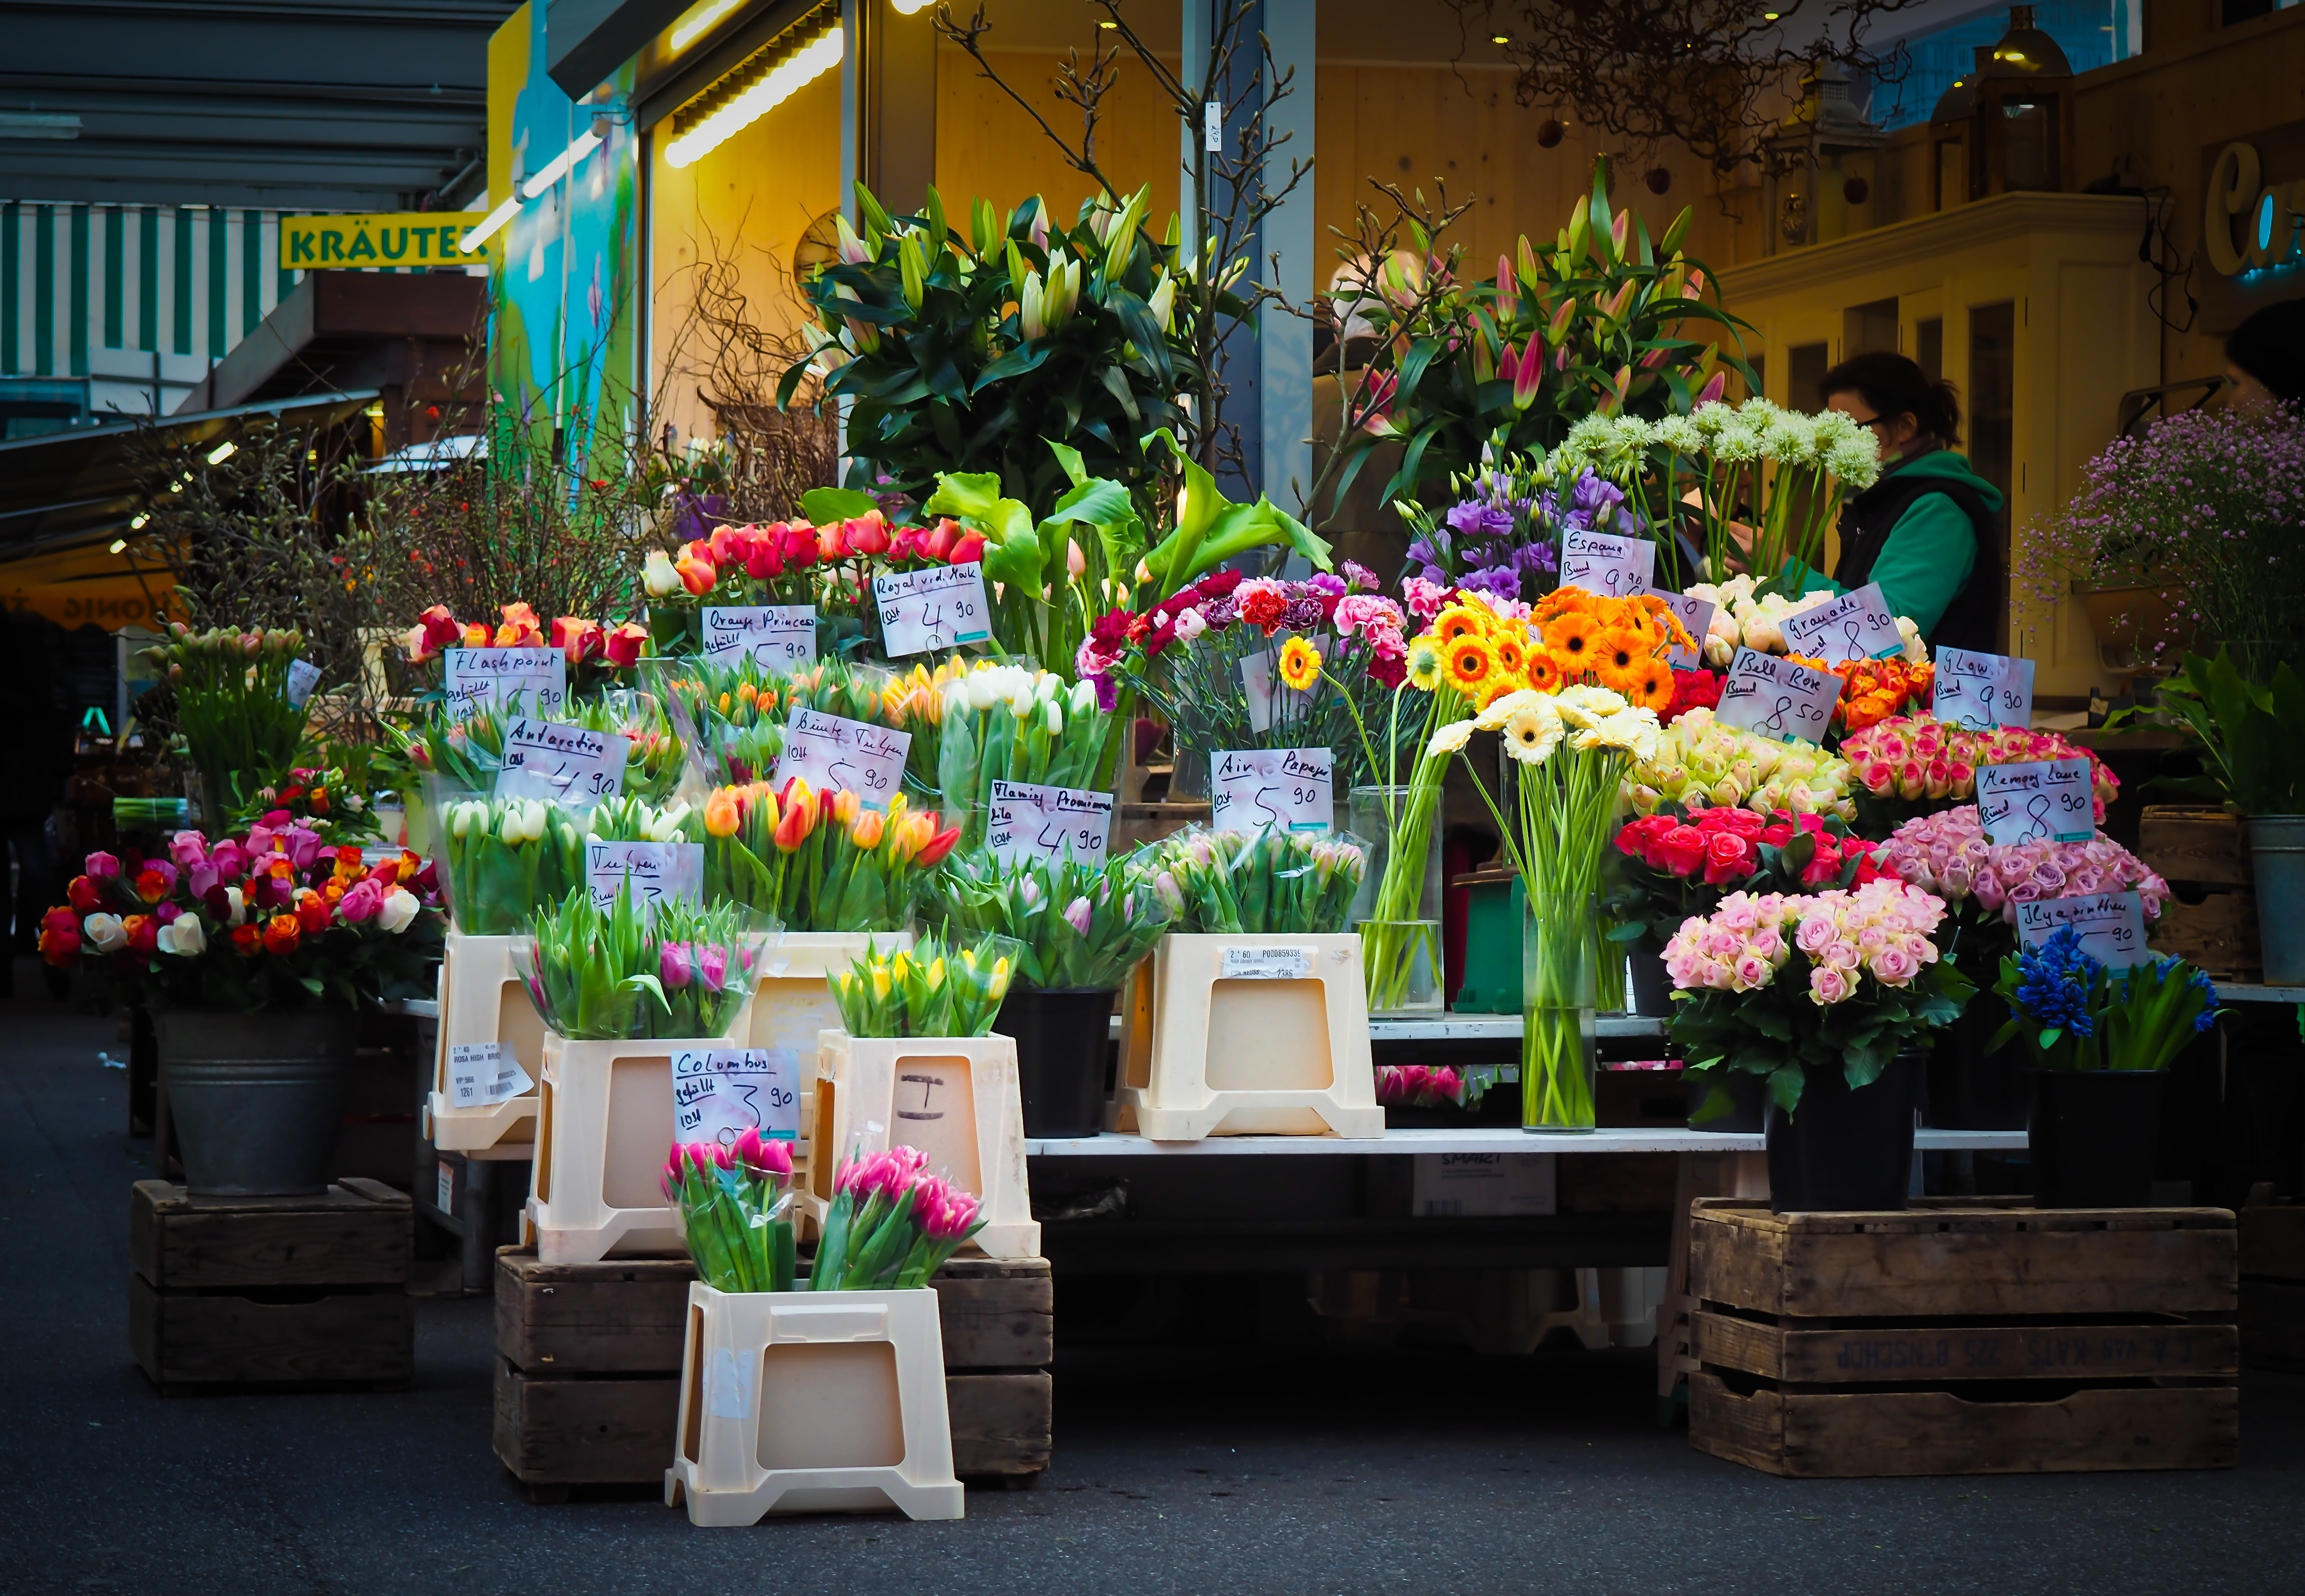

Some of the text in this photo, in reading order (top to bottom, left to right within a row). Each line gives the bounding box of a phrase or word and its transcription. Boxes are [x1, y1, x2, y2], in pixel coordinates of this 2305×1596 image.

[877, 573, 915, 595] Royal
[922, 601, 973, 643] 4 90
[1789, 597, 1856, 640] Granada
[786, 642, 806, 658] 90
[1844, 613, 1890, 662] 8 90
[1737, 652, 1821, 691] Bell Rose
[541, 688, 561, 705] 90
[1766, 696, 1823, 730] 8 50
[2003, 690, 2022, 709] 90
[551, 761, 614, 798] 4 90
[828, 761, 887, 794] 5 90
[1219, 754, 1252, 775] Air
[1983, 770, 2039, 789] Memory
[1253, 787, 1316, 828] 5 90
[2027, 793, 2085, 837] 8 90
[1037, 822, 1101, 856] 4 90
[2112, 927, 2132, 942] 90
[733, 1084, 792, 1131] 3 90
